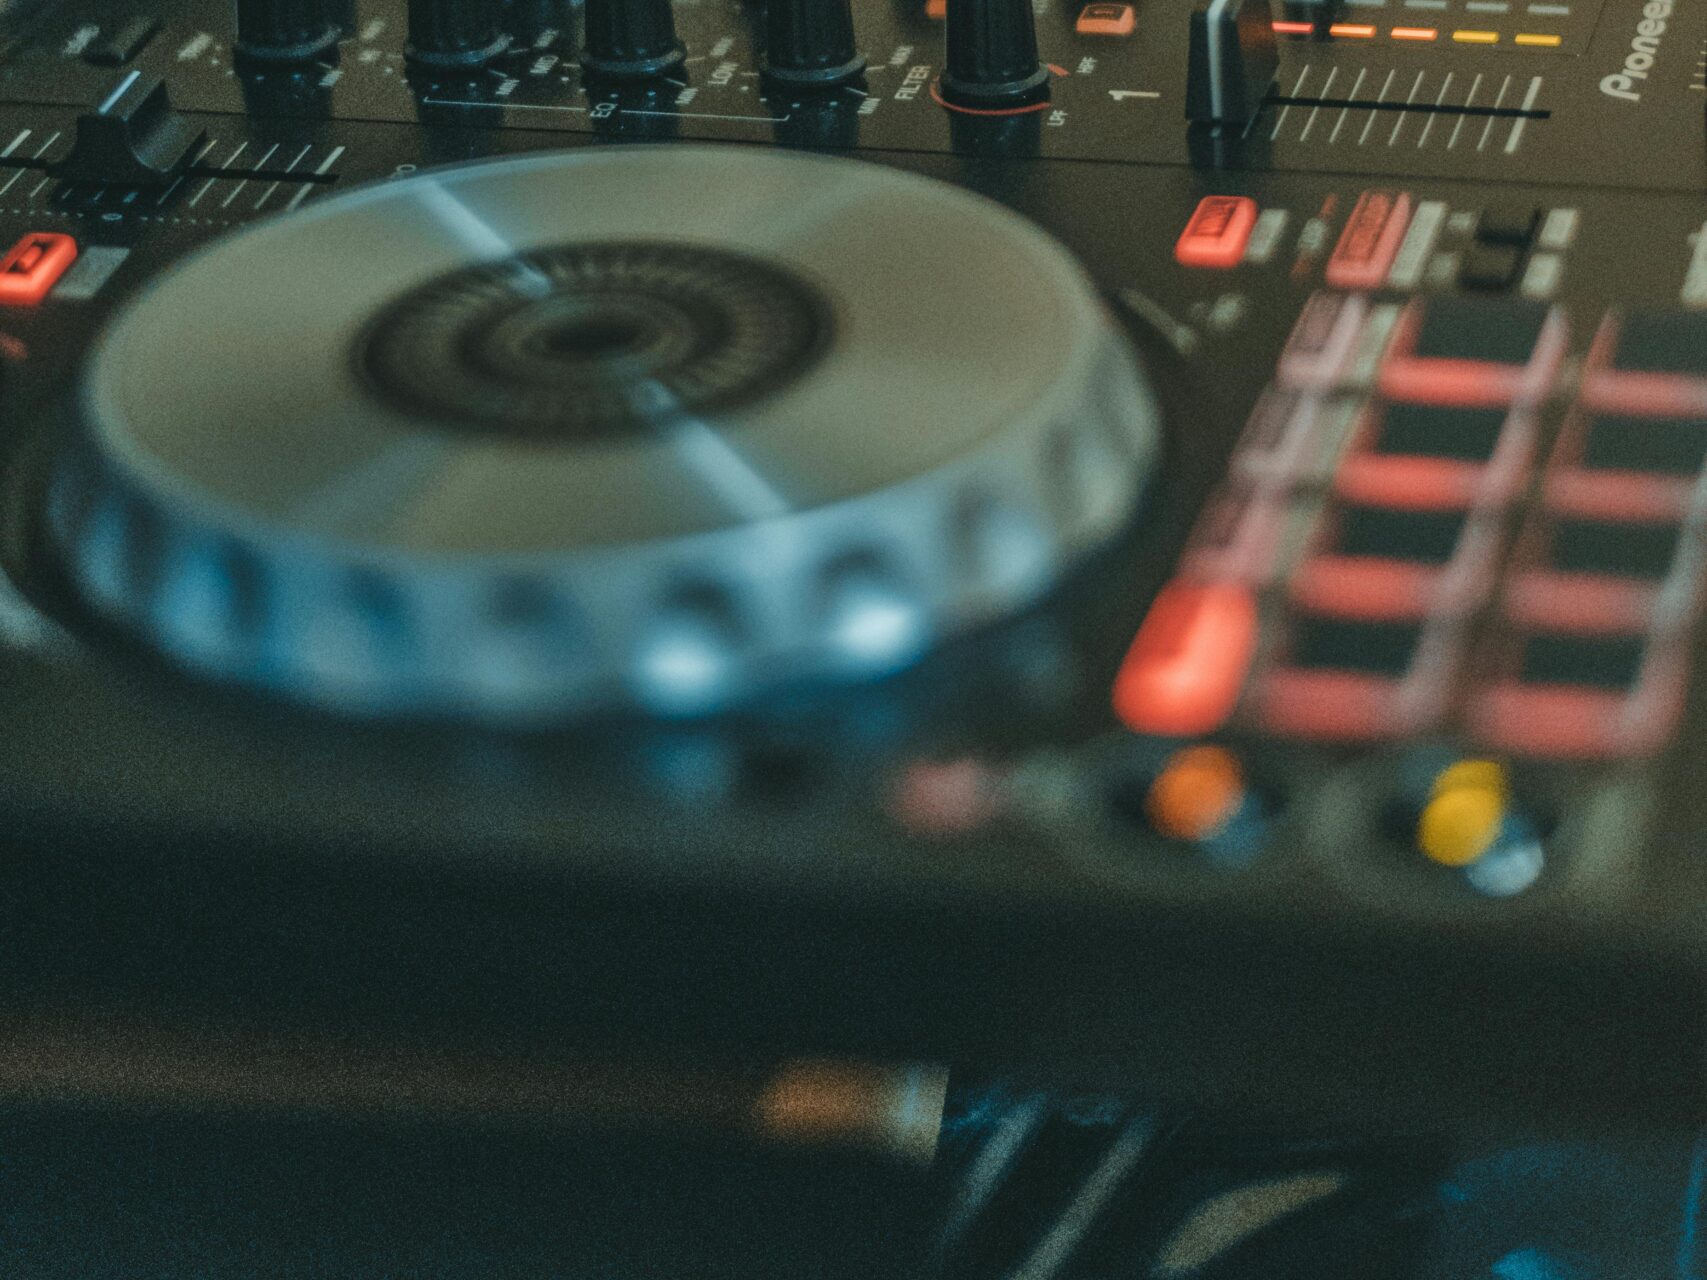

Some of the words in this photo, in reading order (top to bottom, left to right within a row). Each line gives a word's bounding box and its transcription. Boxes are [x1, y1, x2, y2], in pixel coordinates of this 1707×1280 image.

[707, 61, 739, 85] LOW
[894, 64, 932, 100] FILTER
[590, 102, 618, 118] EQ
